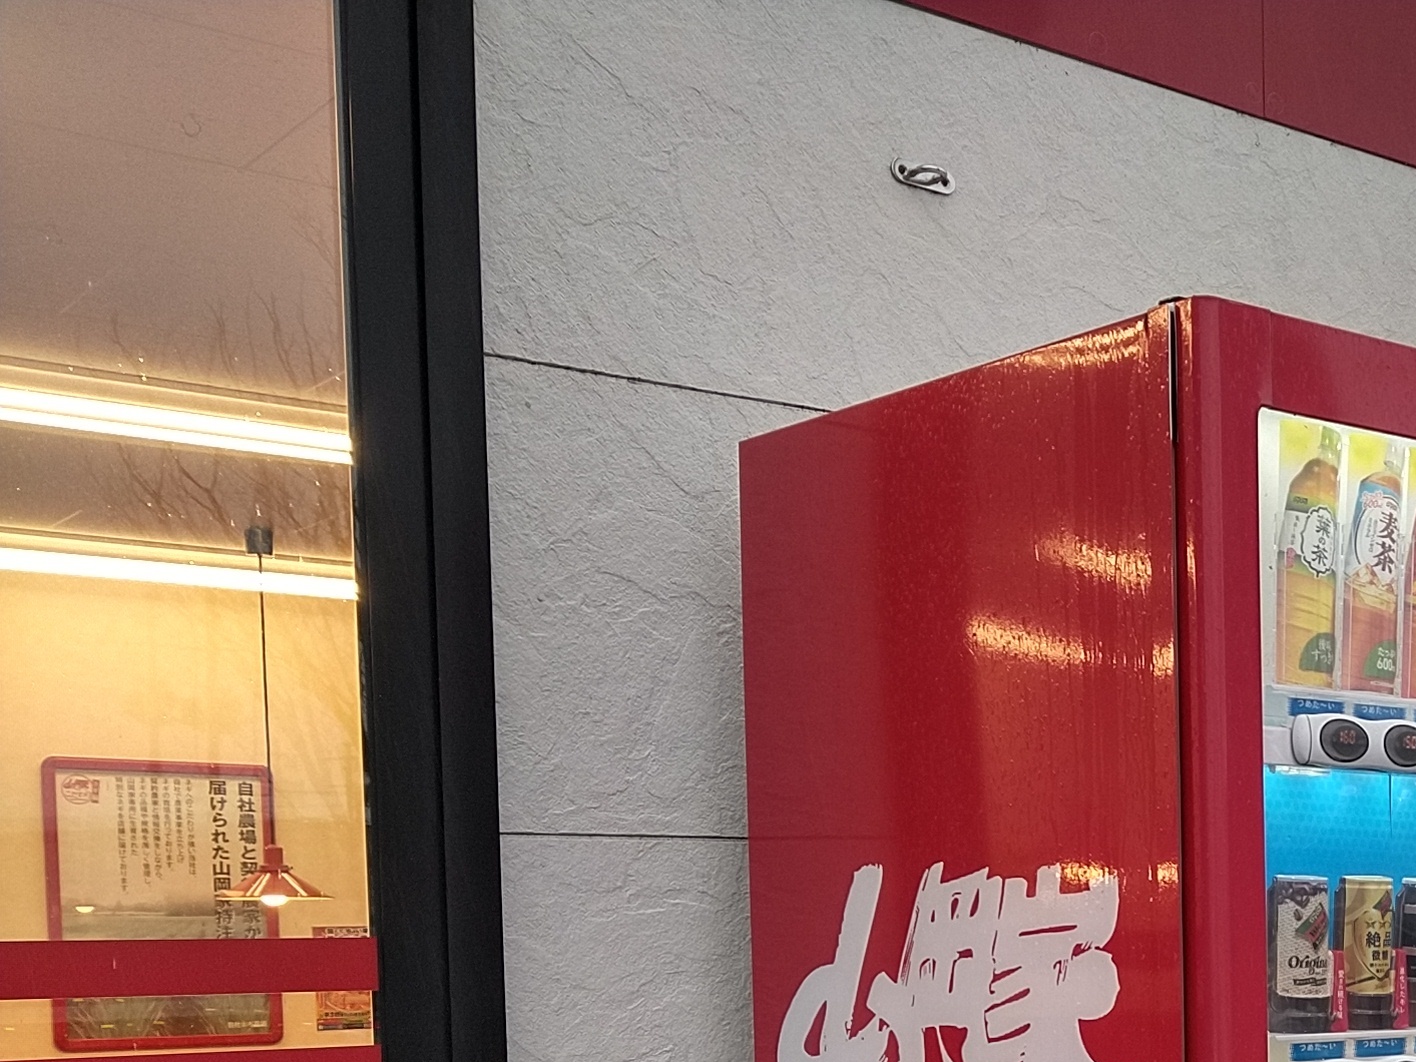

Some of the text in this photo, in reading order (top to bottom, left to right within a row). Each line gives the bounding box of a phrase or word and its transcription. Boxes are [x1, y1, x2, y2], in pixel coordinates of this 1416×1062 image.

[1312, 515, 1331, 567] 葉の茶
[1373, 511, 1398, 574] 麦茶
[238, 782, 262, 939] 自社農場と契家が
